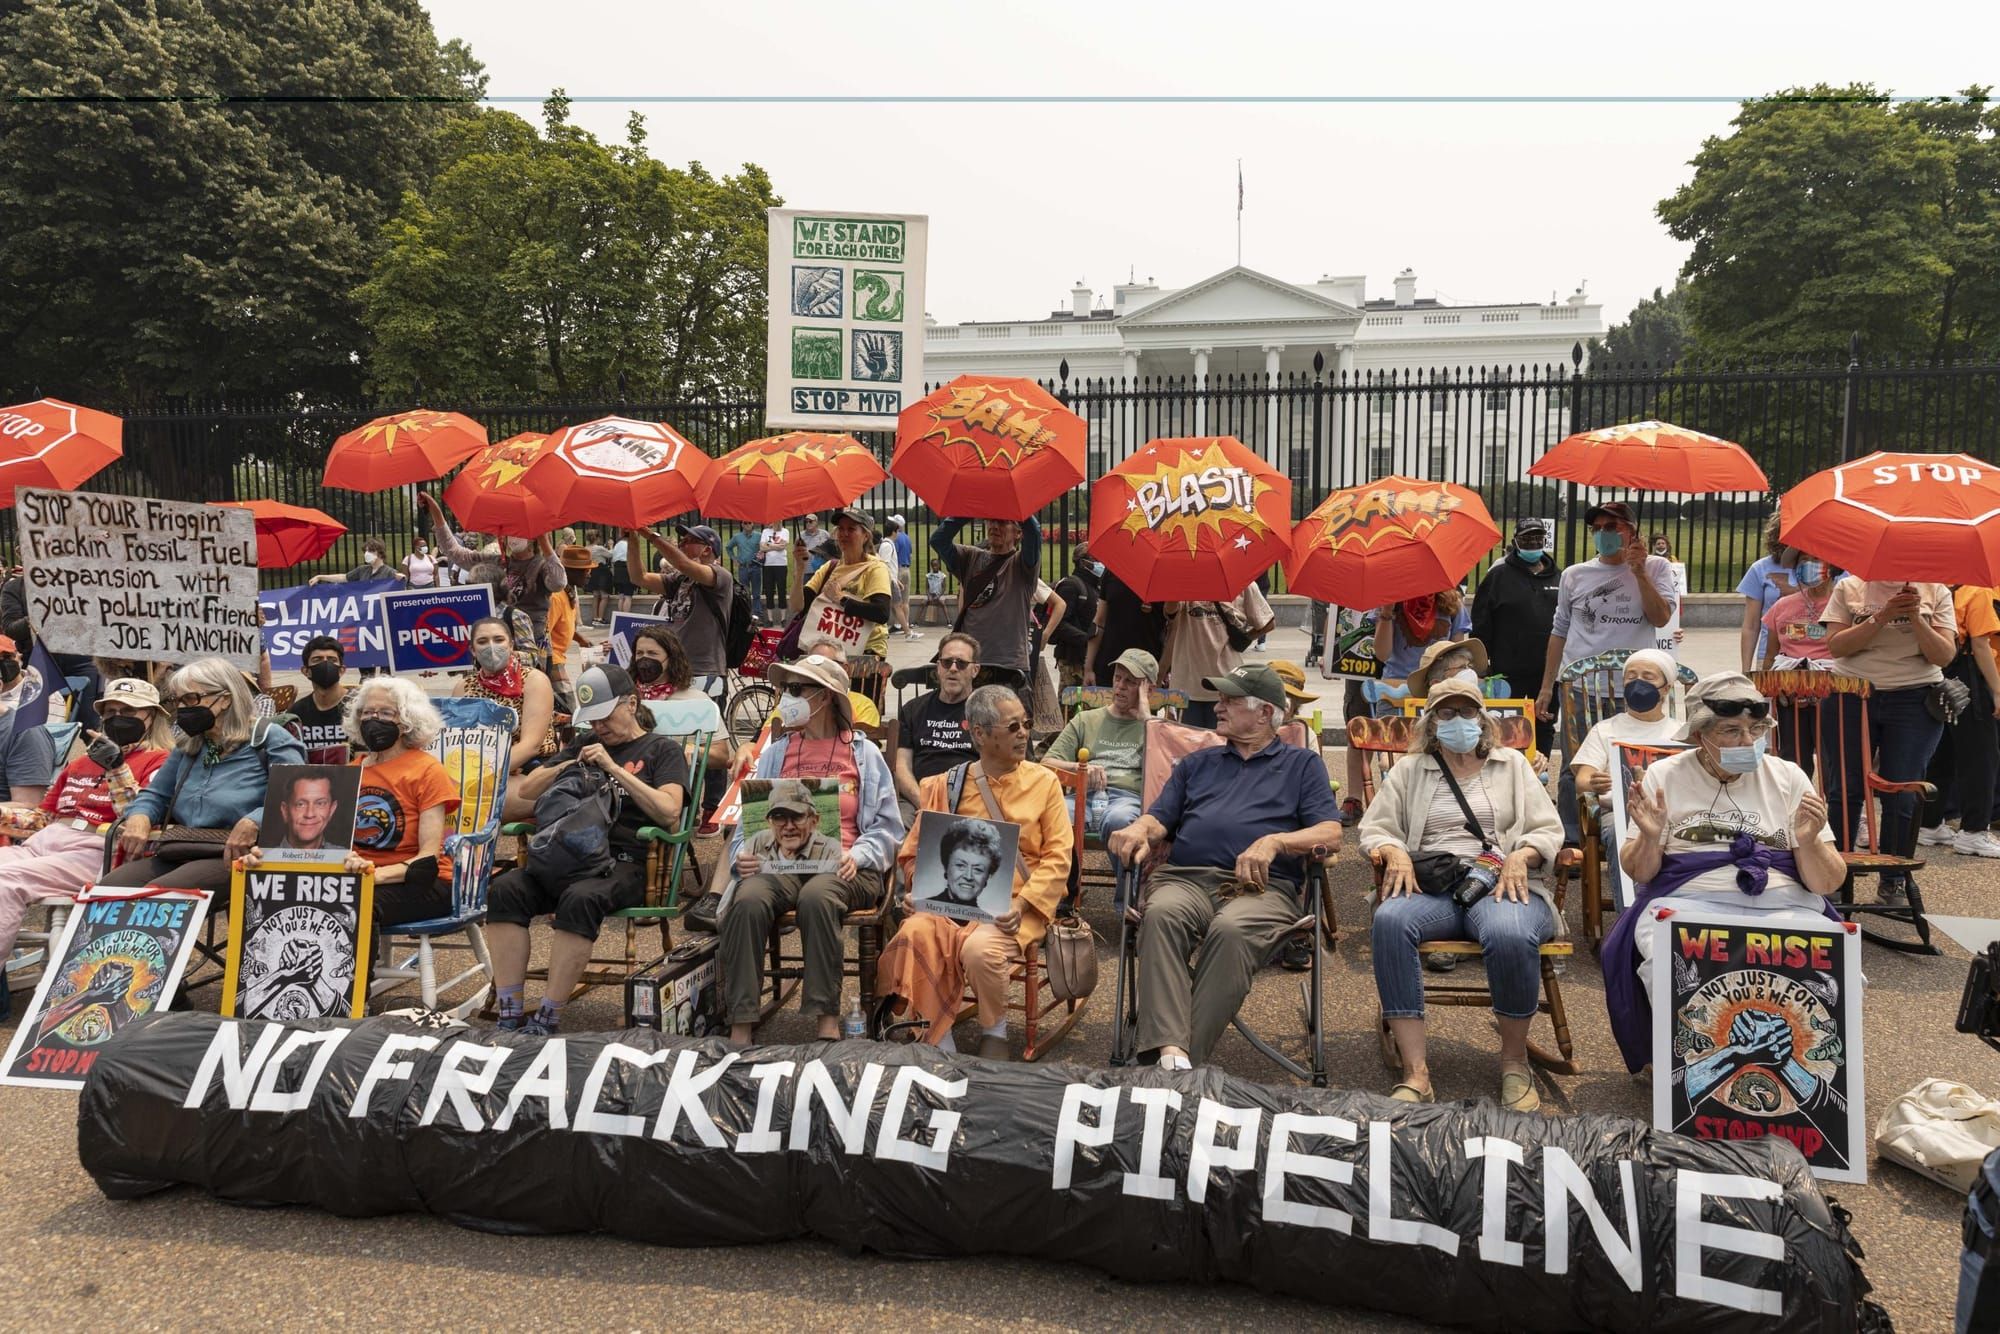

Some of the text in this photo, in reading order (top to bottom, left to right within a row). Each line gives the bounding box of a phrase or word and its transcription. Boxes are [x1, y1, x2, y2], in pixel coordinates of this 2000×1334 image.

[798, 222, 900, 245] WE STAND
[797, 241, 900, 260] FOR EACH OTHER
[795, 391, 897, 412] STOP MVP
[0, 413, 45, 439] TOP
[1873, 462, 1982, 485] STOP
[1137, 467, 1254, 530] BLAST!
[24, 491, 225, 541] STOP YOUR Friggin'
[29, 566, 232, 598] expansion with
[34, 595, 90, 628] your
[203, 596, 260, 628] Friend
[259, 594, 380, 627] CLIMAT
[393, 594, 481, 610] preservethenrv.com
[822, 606, 864, 630] STOP
[110, 622, 150, 650] JOE
[398, 625, 472, 647] PIPELIN
[819, 617, 861, 646] MVP!
[1340, 658, 1370, 674] STOP
[302, 724, 347, 740] GREE
[927, 719, 959, 728] Virginia
[932, 729, 962, 739] is NOT
[920, 738, 972, 749] for Pipelines
[249, 873, 356, 903] WE RISE
[88, 901, 189, 928] WE RISE
[262, 907, 343, 939] NOT JUST FOR
[277, 920, 325, 937] YOU & ME
[85, 931, 161, 962] NOT JUST FOR
[99, 942, 145, 959] YOU & ME
[1678, 927, 1833, 970] WE RISE
[1701, 971, 1819, 1013] NOT JUST FOR
[1722, 987, 1789, 1008] YOU & ME
[26, 1047, 80, 1073] STOP
[1695, 1115, 1763, 1140] STOP
[183, 1021, 1784, 1316] NO FRACKING PIPELINE
